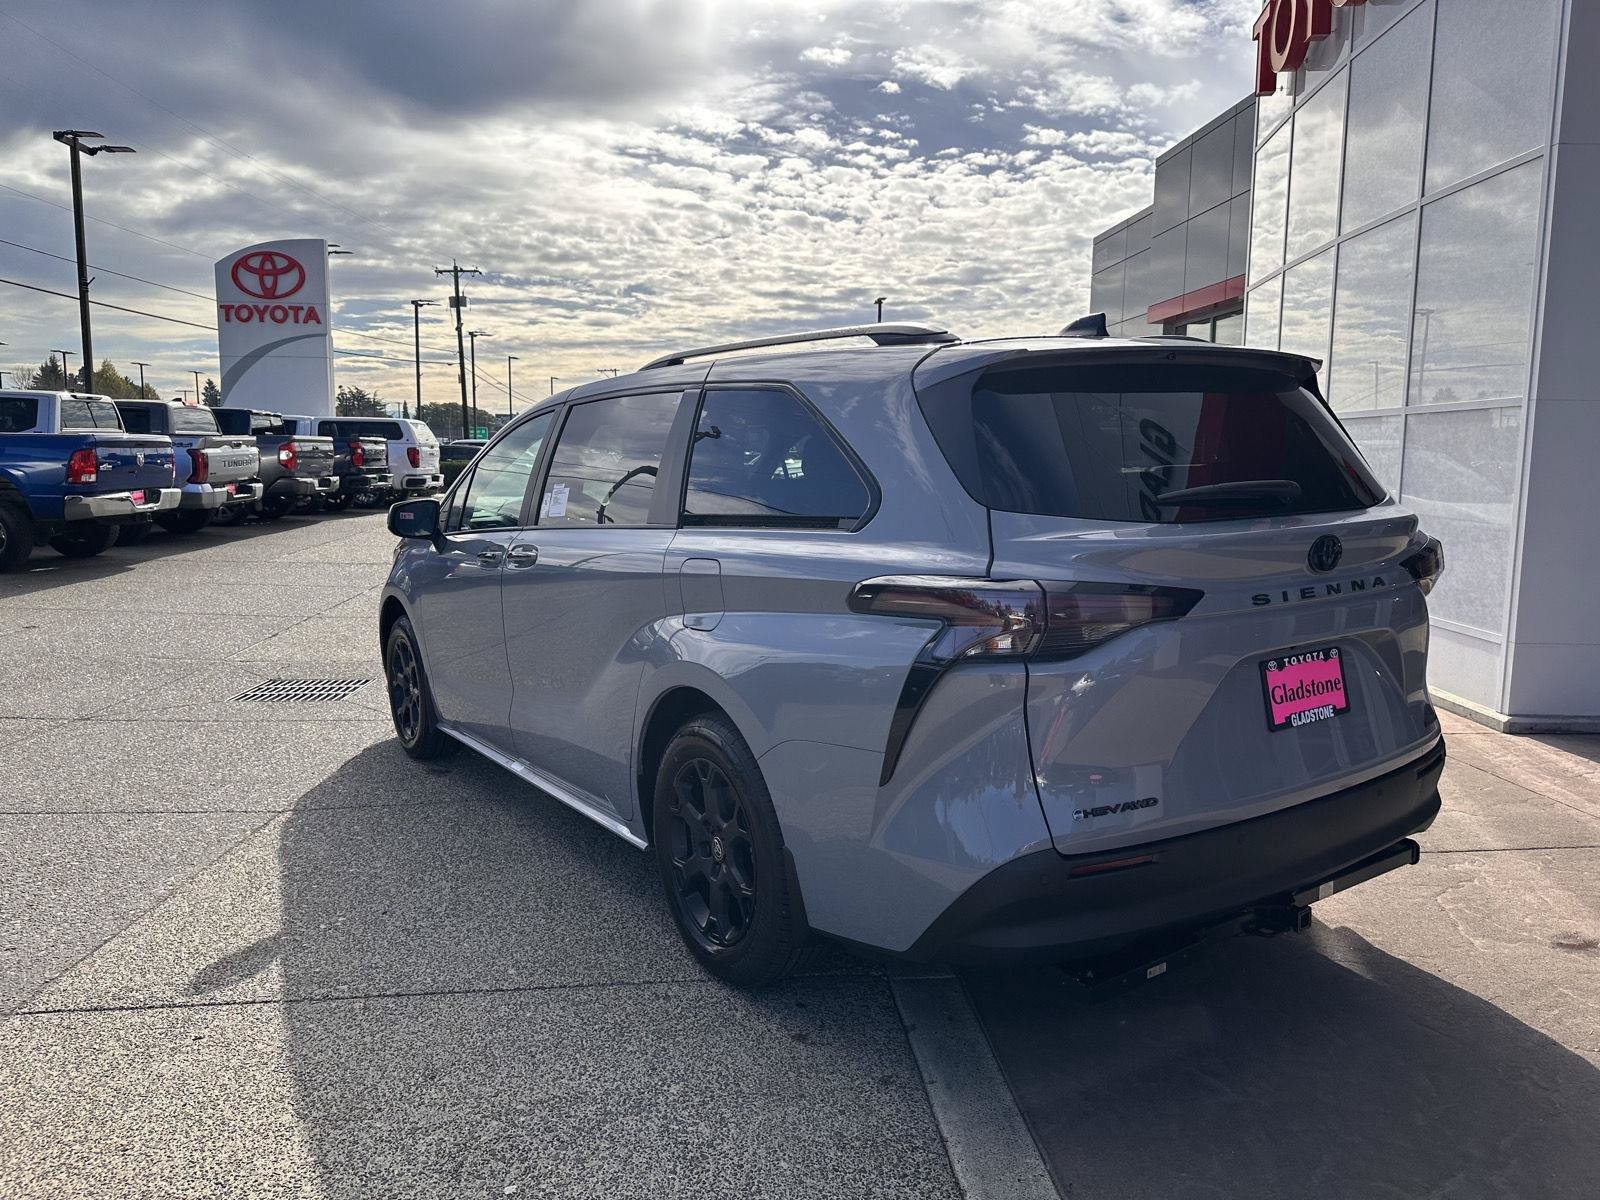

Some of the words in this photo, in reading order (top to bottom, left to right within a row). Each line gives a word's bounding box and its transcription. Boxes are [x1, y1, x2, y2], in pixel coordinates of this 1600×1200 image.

[219, 303, 322, 324] TOYOTA
[1252, 576, 1388, 606] SIENNA
[1284, 651, 1325, 667] TOYOTA
[1271, 677, 1342, 705] Gladstone
[1291, 704, 1335, 727] GLADSTONE
